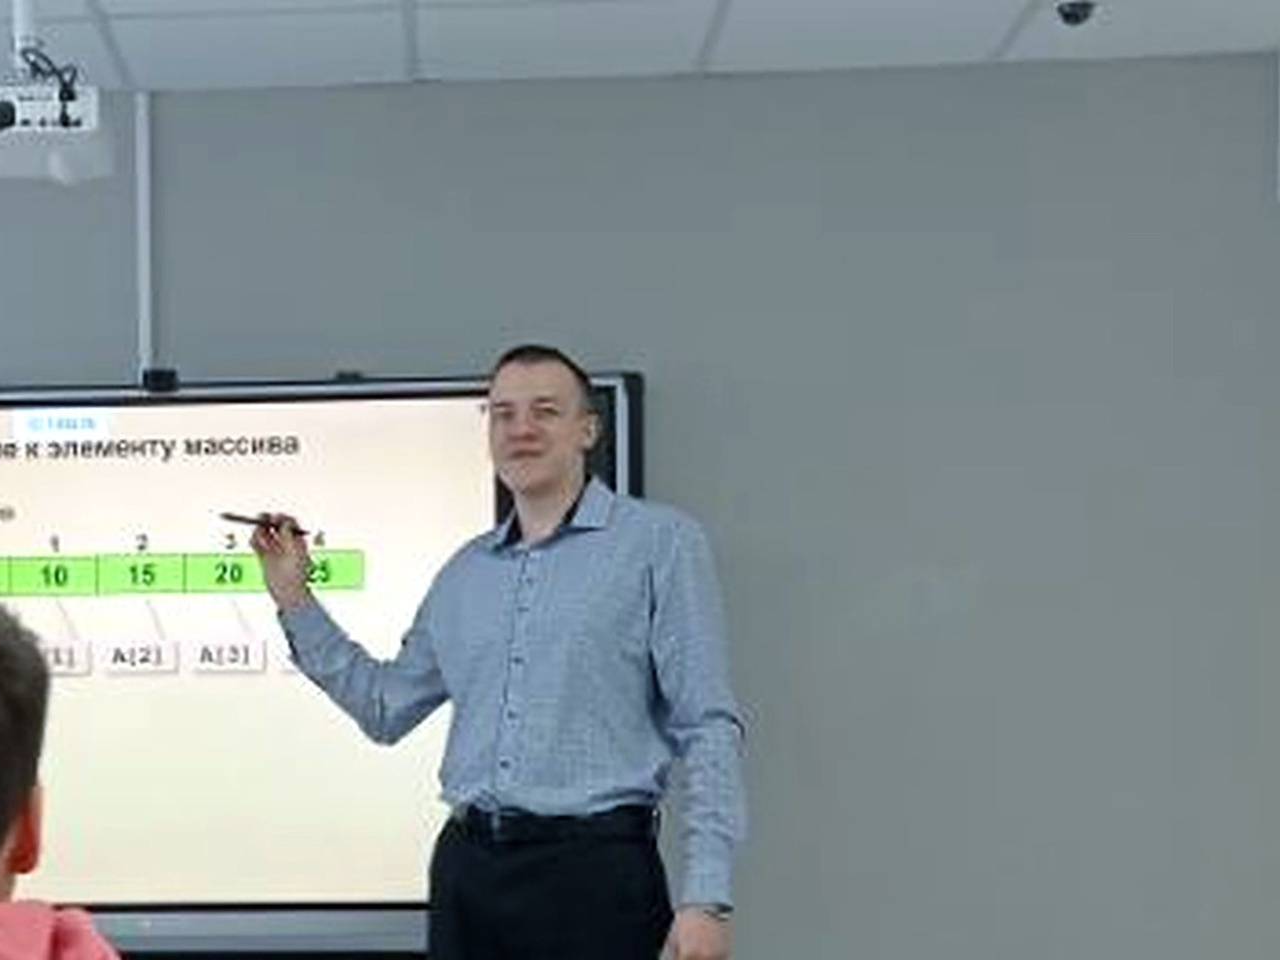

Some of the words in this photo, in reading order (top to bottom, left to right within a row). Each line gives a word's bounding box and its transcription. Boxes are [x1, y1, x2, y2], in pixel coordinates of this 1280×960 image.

[25, 442, 39, 459] к
[47, 439, 176, 463] элементу
[183, 436, 300, 456] массива
[136, 533, 149, 551] 2
[41, 564, 69, 587] 10
[128, 562, 156, 586] 15
[214, 562, 244, 584] 20
